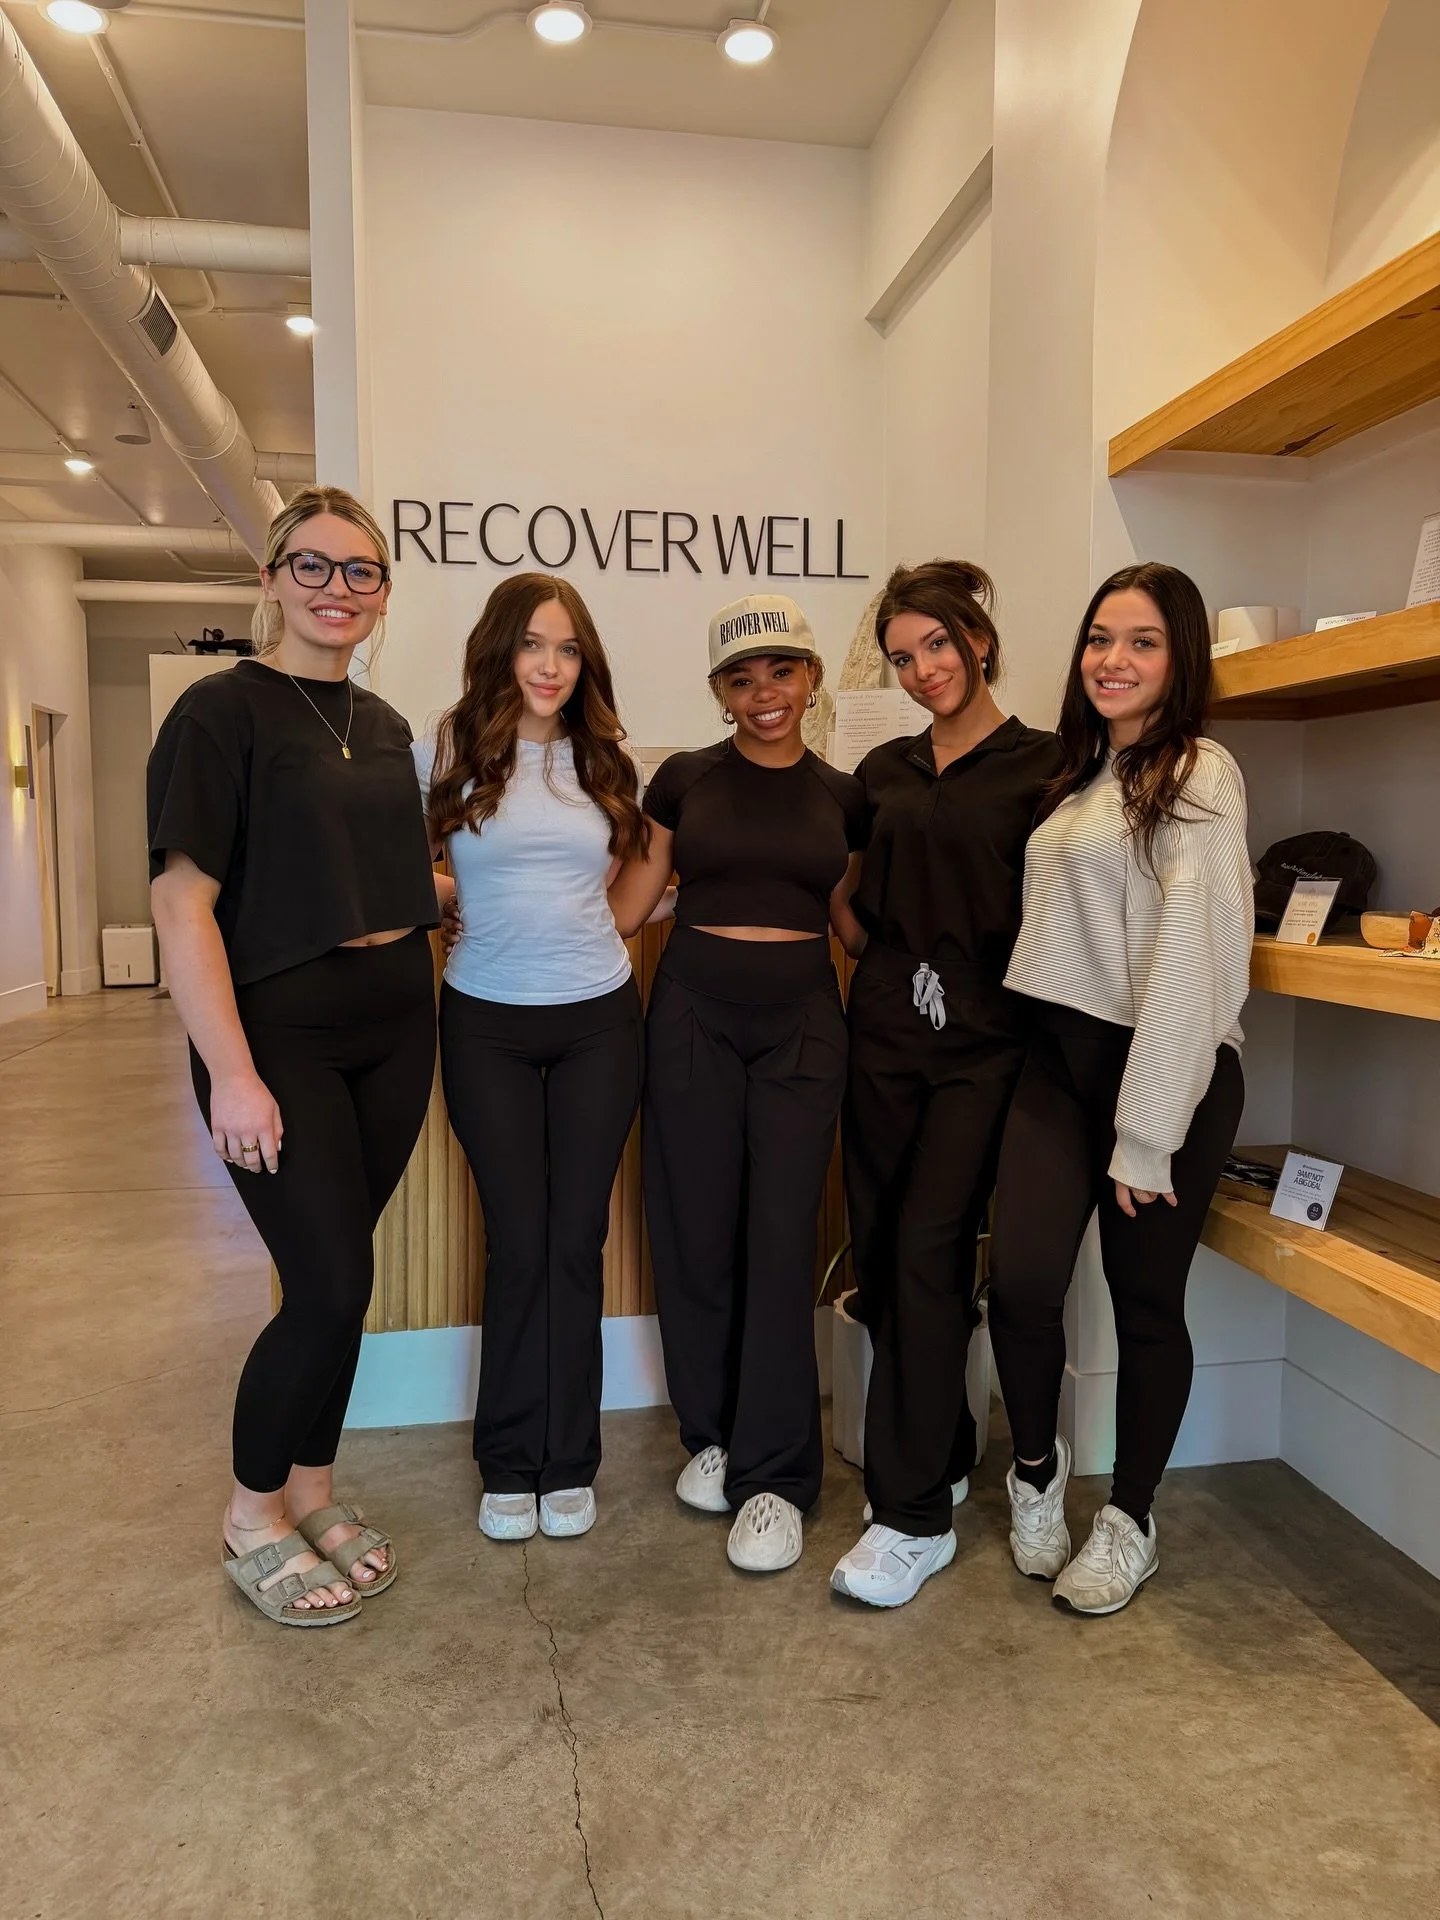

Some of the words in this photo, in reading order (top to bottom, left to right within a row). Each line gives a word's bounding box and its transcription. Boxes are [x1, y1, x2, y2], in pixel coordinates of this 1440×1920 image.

[393, 498, 702, 574] RECOVER
[712, 514, 870, 578] WELL
[720, 612, 761, 646] RECOVER
[761, 611, 790, 633] WELL
